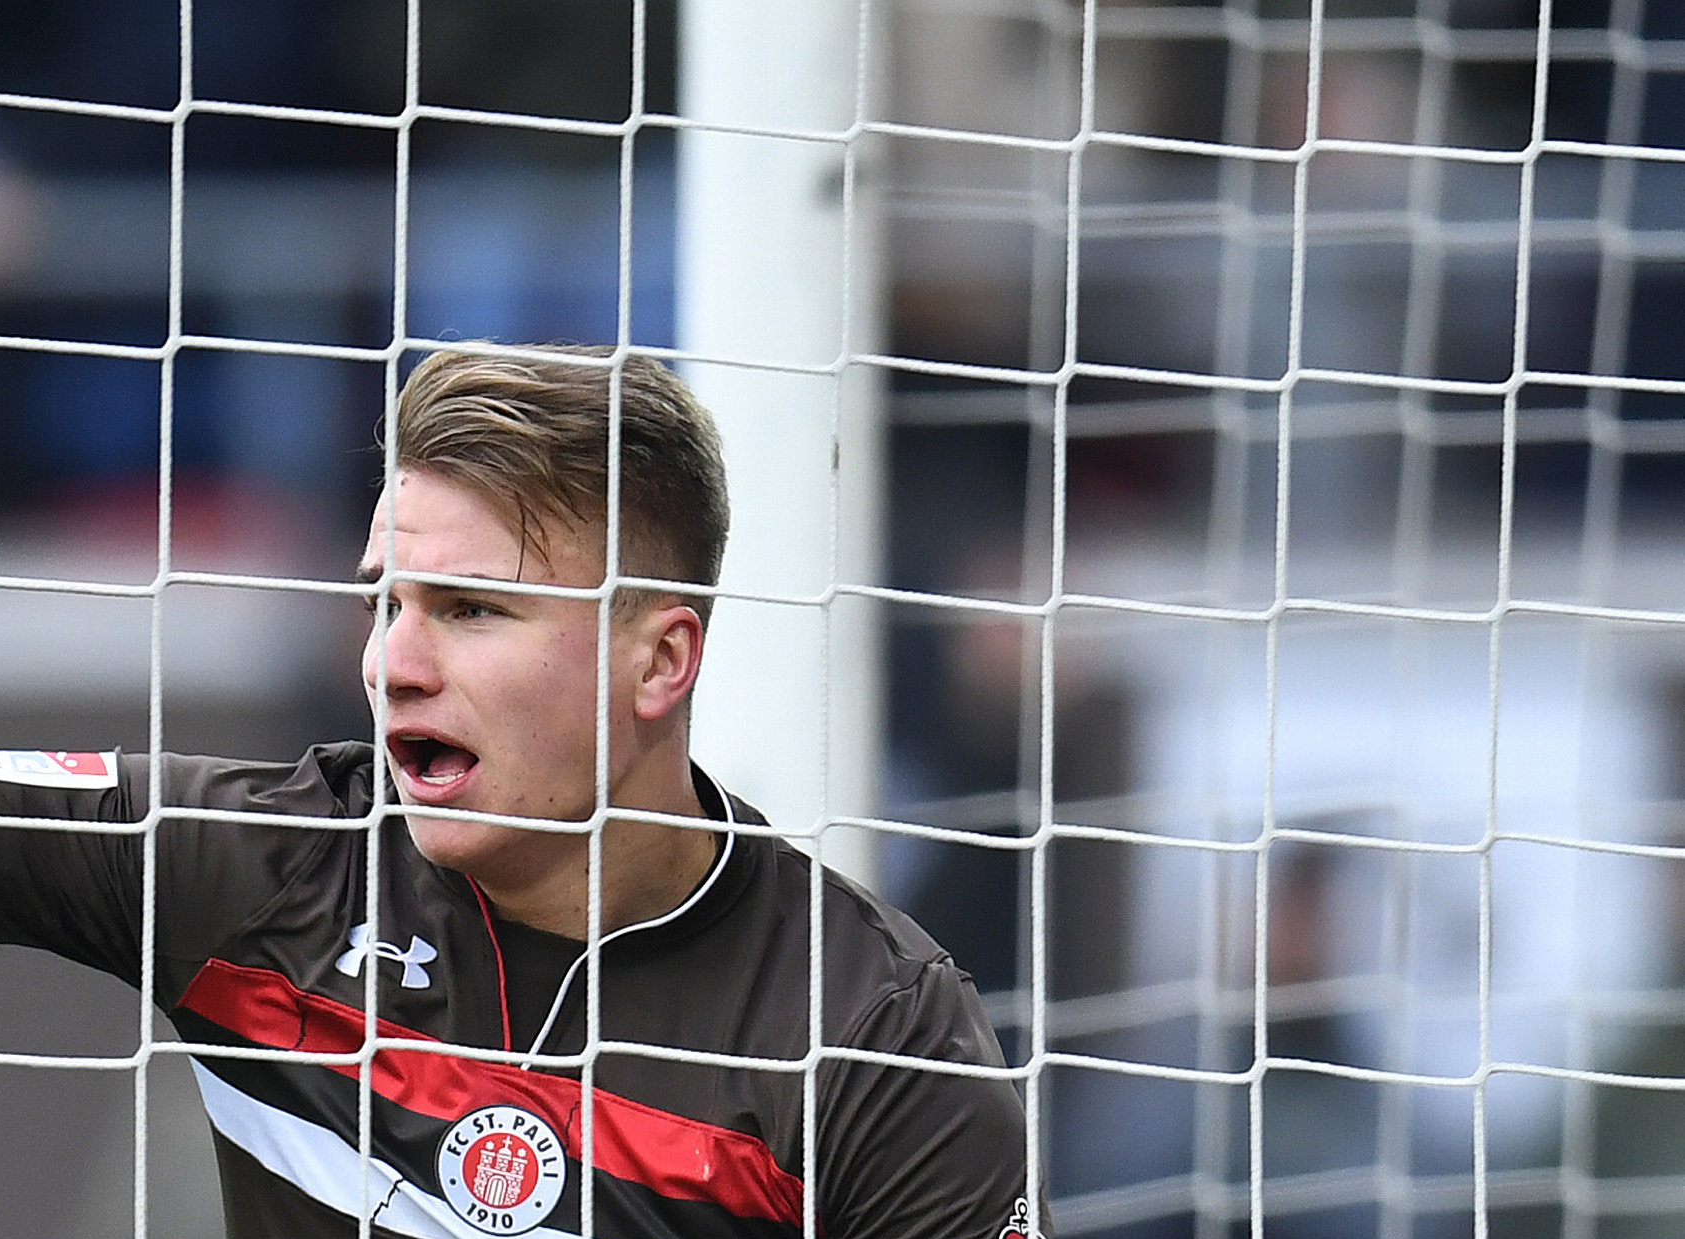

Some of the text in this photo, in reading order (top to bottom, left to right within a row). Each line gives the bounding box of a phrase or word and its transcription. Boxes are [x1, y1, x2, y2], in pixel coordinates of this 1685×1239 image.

[446, 1113, 560, 1179] FC ST. PAULI
[466, 1202, 514, 1229] 1910
